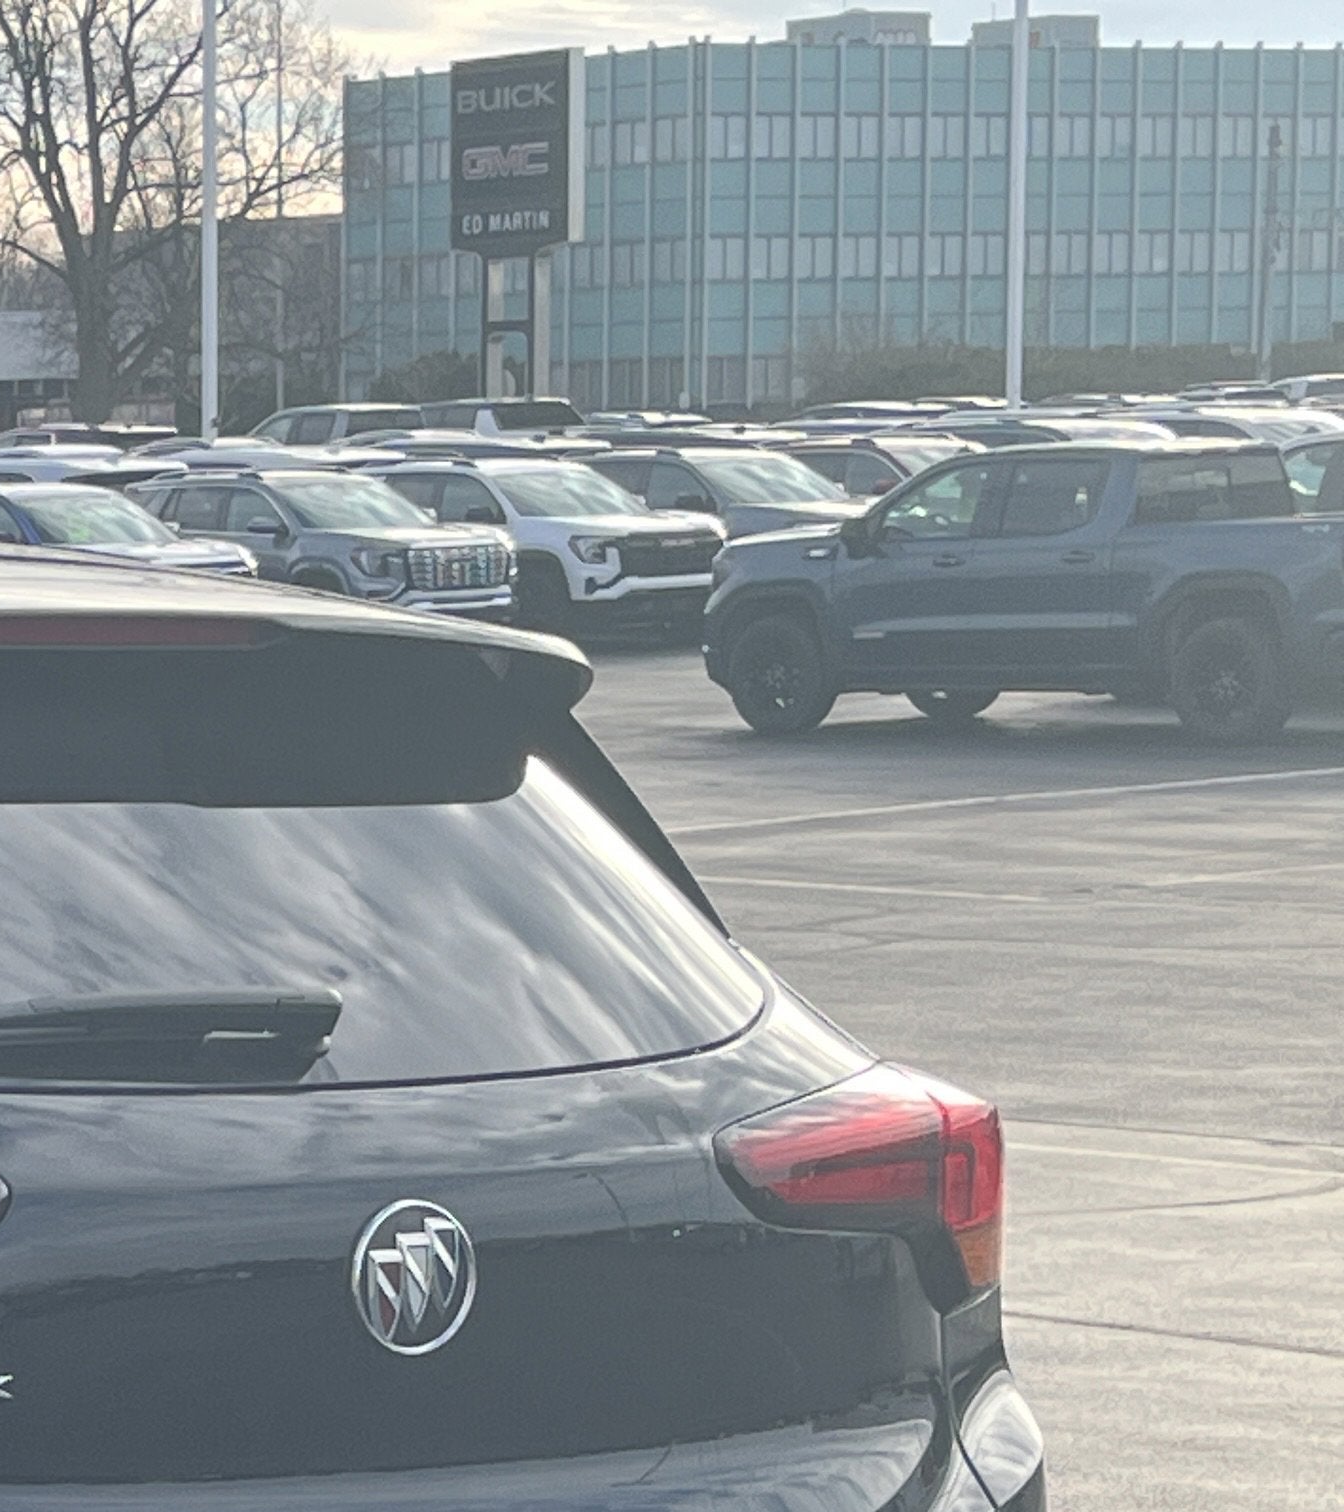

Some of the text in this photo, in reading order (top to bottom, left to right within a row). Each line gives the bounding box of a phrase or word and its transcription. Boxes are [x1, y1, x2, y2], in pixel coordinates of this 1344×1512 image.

[457, 81, 555, 114] BUICK
[463, 141, 549, 180] GMC
[462, 210, 550, 234] ED MARTIN
